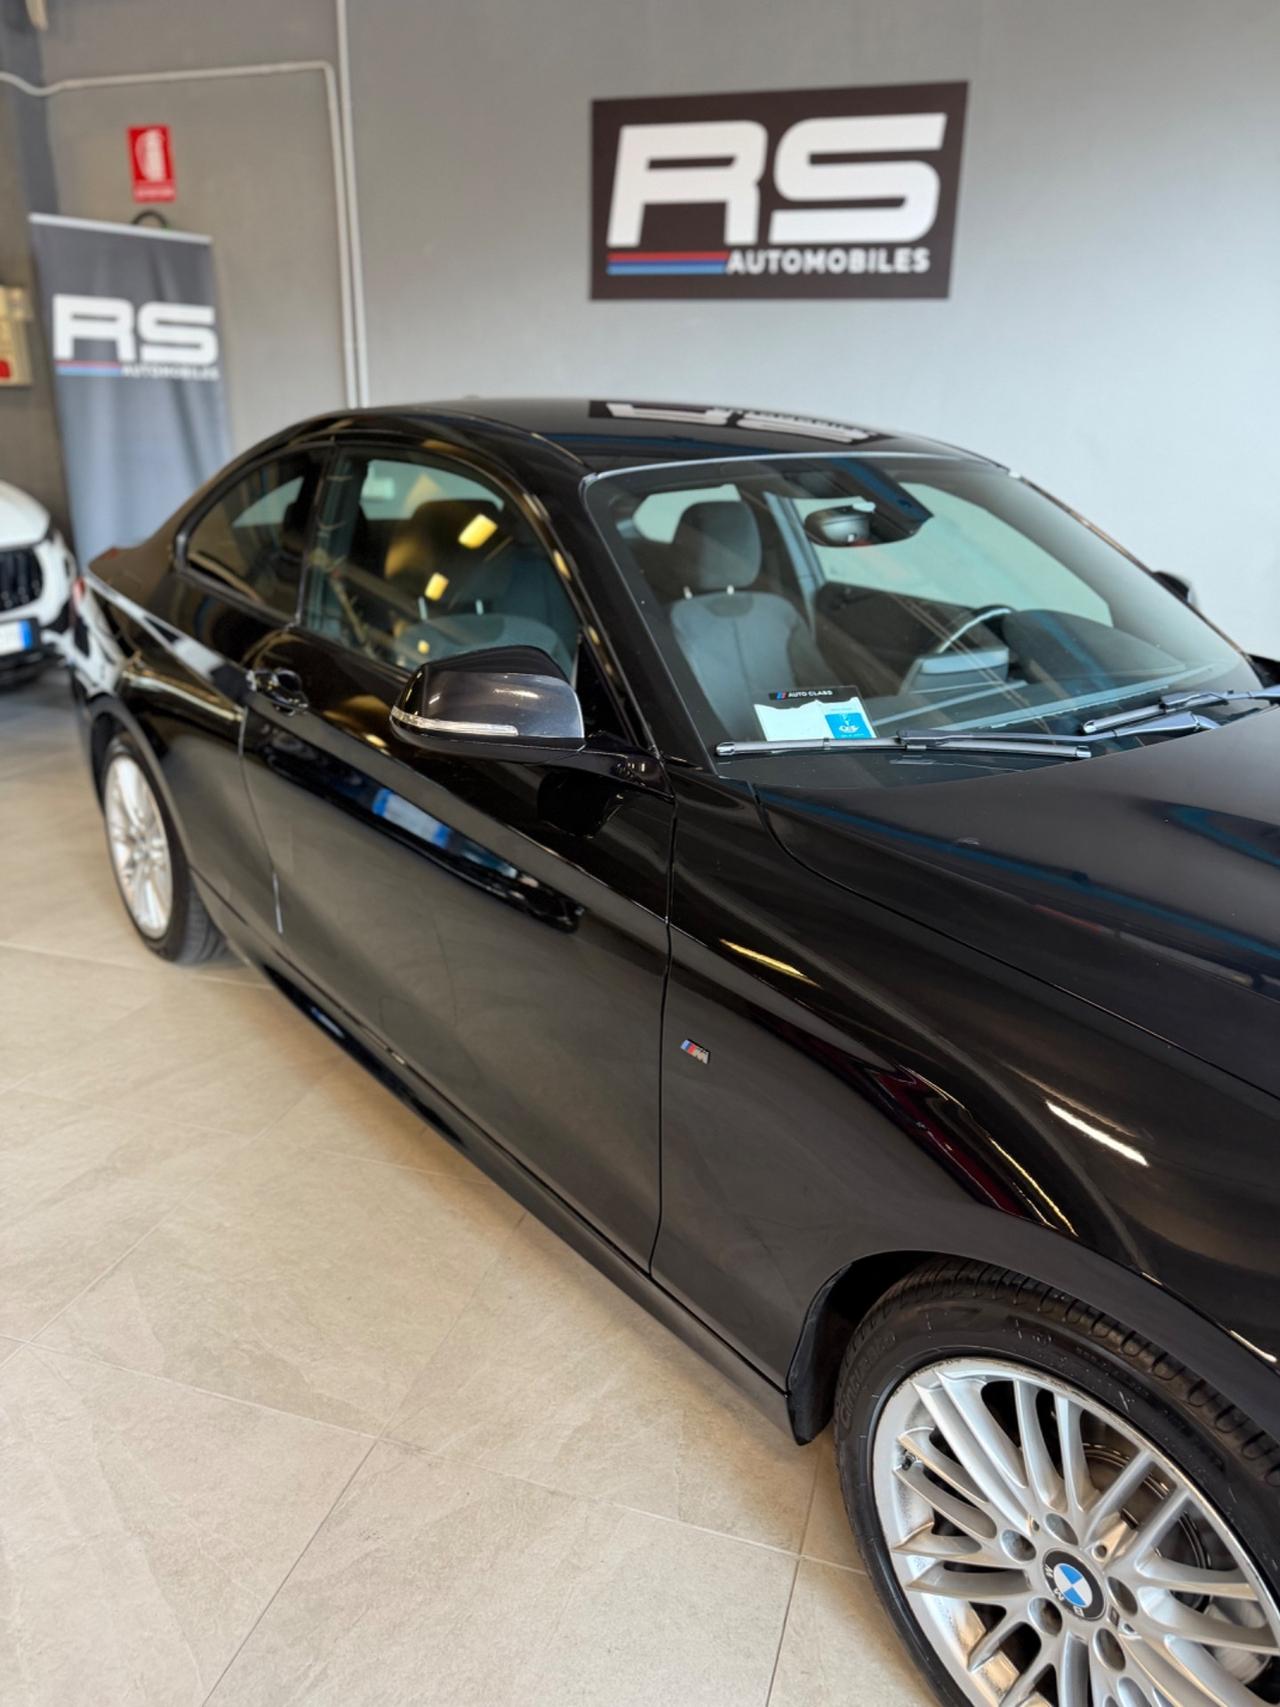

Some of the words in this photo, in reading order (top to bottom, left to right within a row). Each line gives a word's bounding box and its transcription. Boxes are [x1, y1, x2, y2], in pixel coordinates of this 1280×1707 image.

[606, 112, 947, 248] RS
[725, 247, 930, 275] AUTOMOBILES
[53, 293, 219, 365] RS
[788, 690, 808, 699] AUTO
